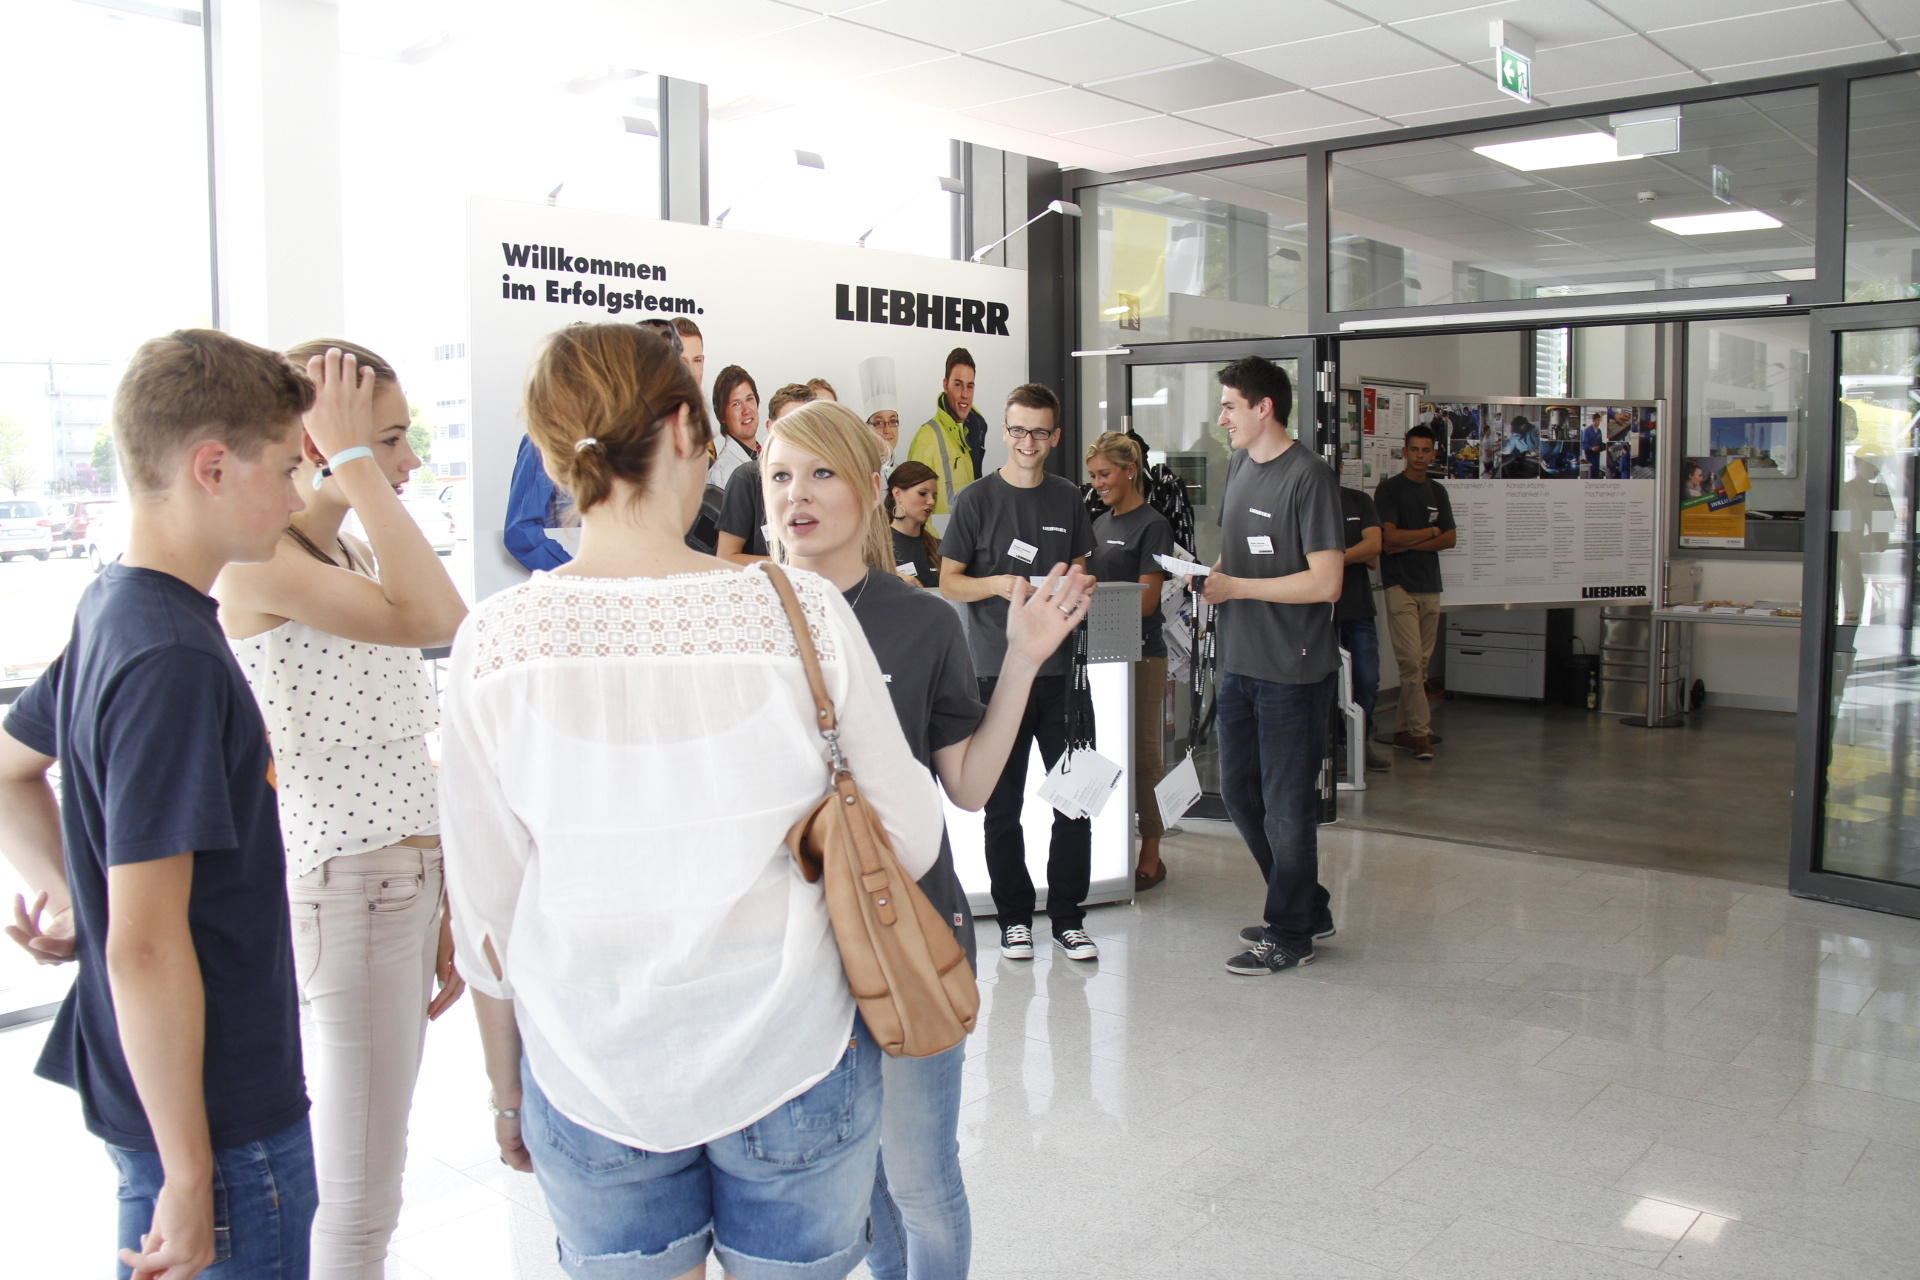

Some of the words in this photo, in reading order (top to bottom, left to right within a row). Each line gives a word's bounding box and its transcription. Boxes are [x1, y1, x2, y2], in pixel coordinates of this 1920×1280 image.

[502, 242, 667, 282] Willkommen
[502, 274, 536, 301] im
[545, 278, 705, 316] Erfolgsteam.
[835, 283, 1010, 337] LIEBHERR
[1581, 585, 1647, 599] LIEBHERR
